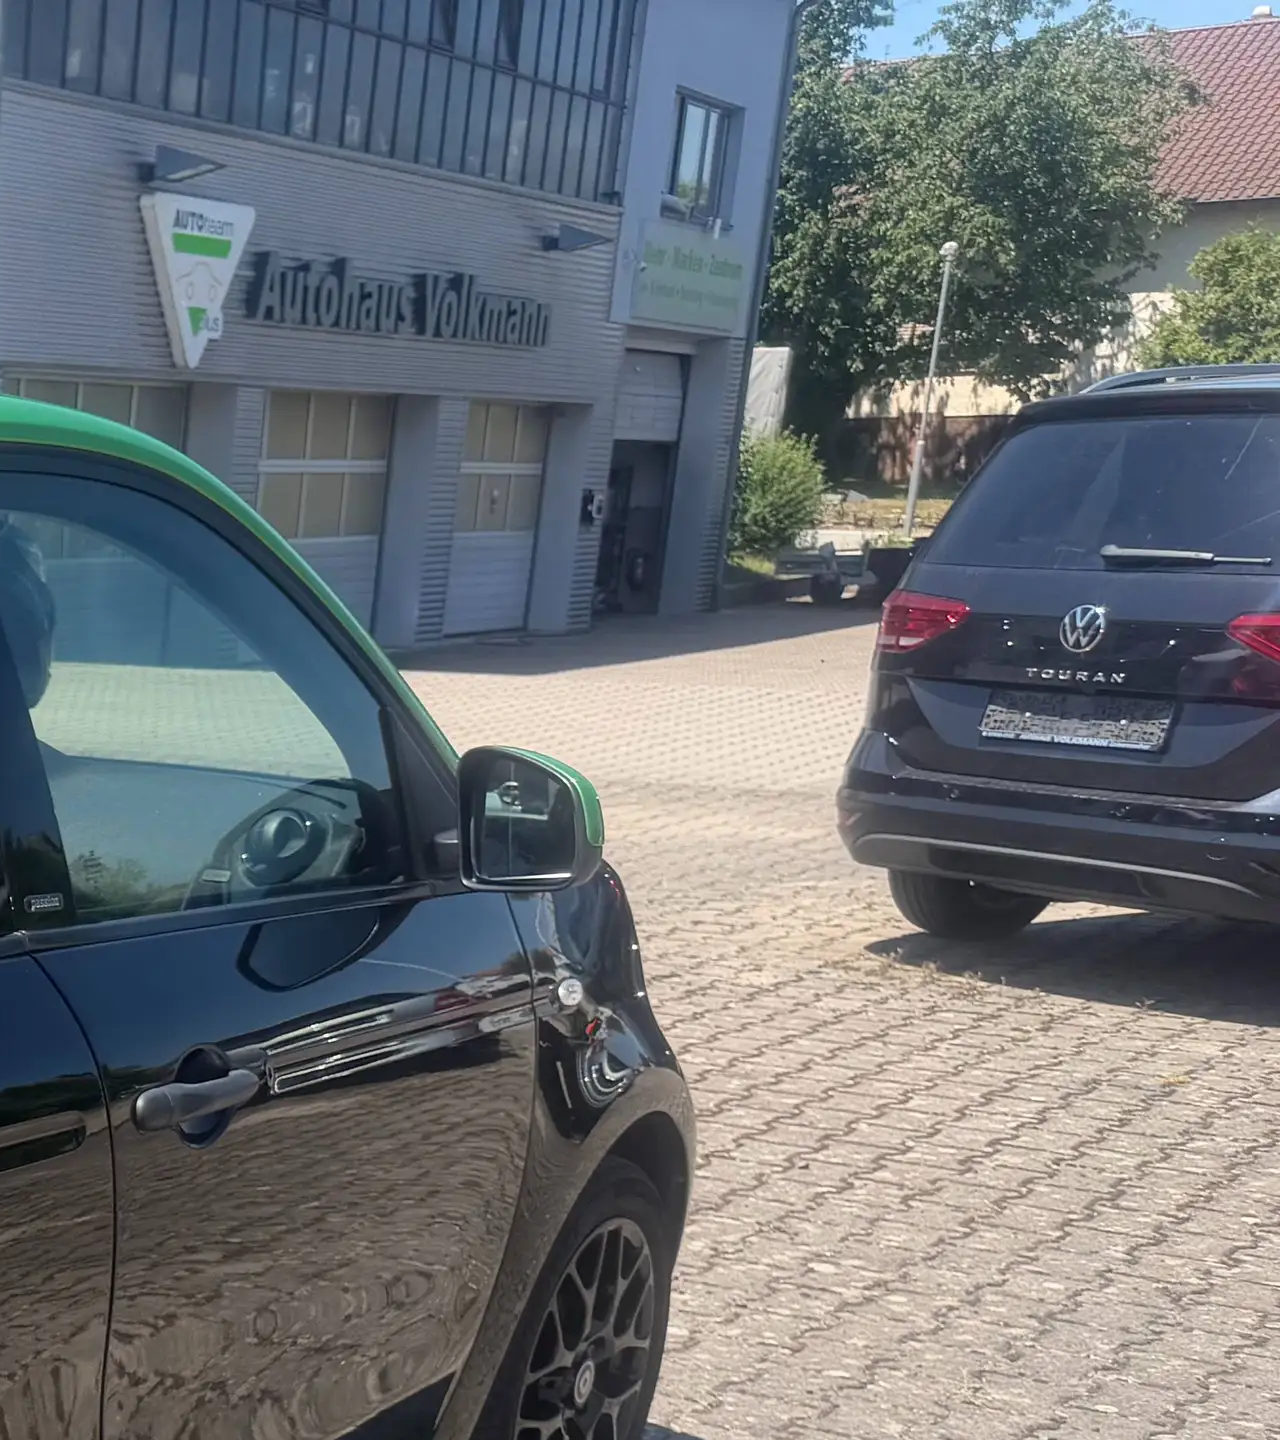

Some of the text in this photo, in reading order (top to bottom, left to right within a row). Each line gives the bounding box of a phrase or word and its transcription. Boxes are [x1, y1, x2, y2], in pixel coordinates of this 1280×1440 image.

[255, 251, 552, 347] Autohaus Volkmann
[1026, 667, 1127, 684] TOURAN
